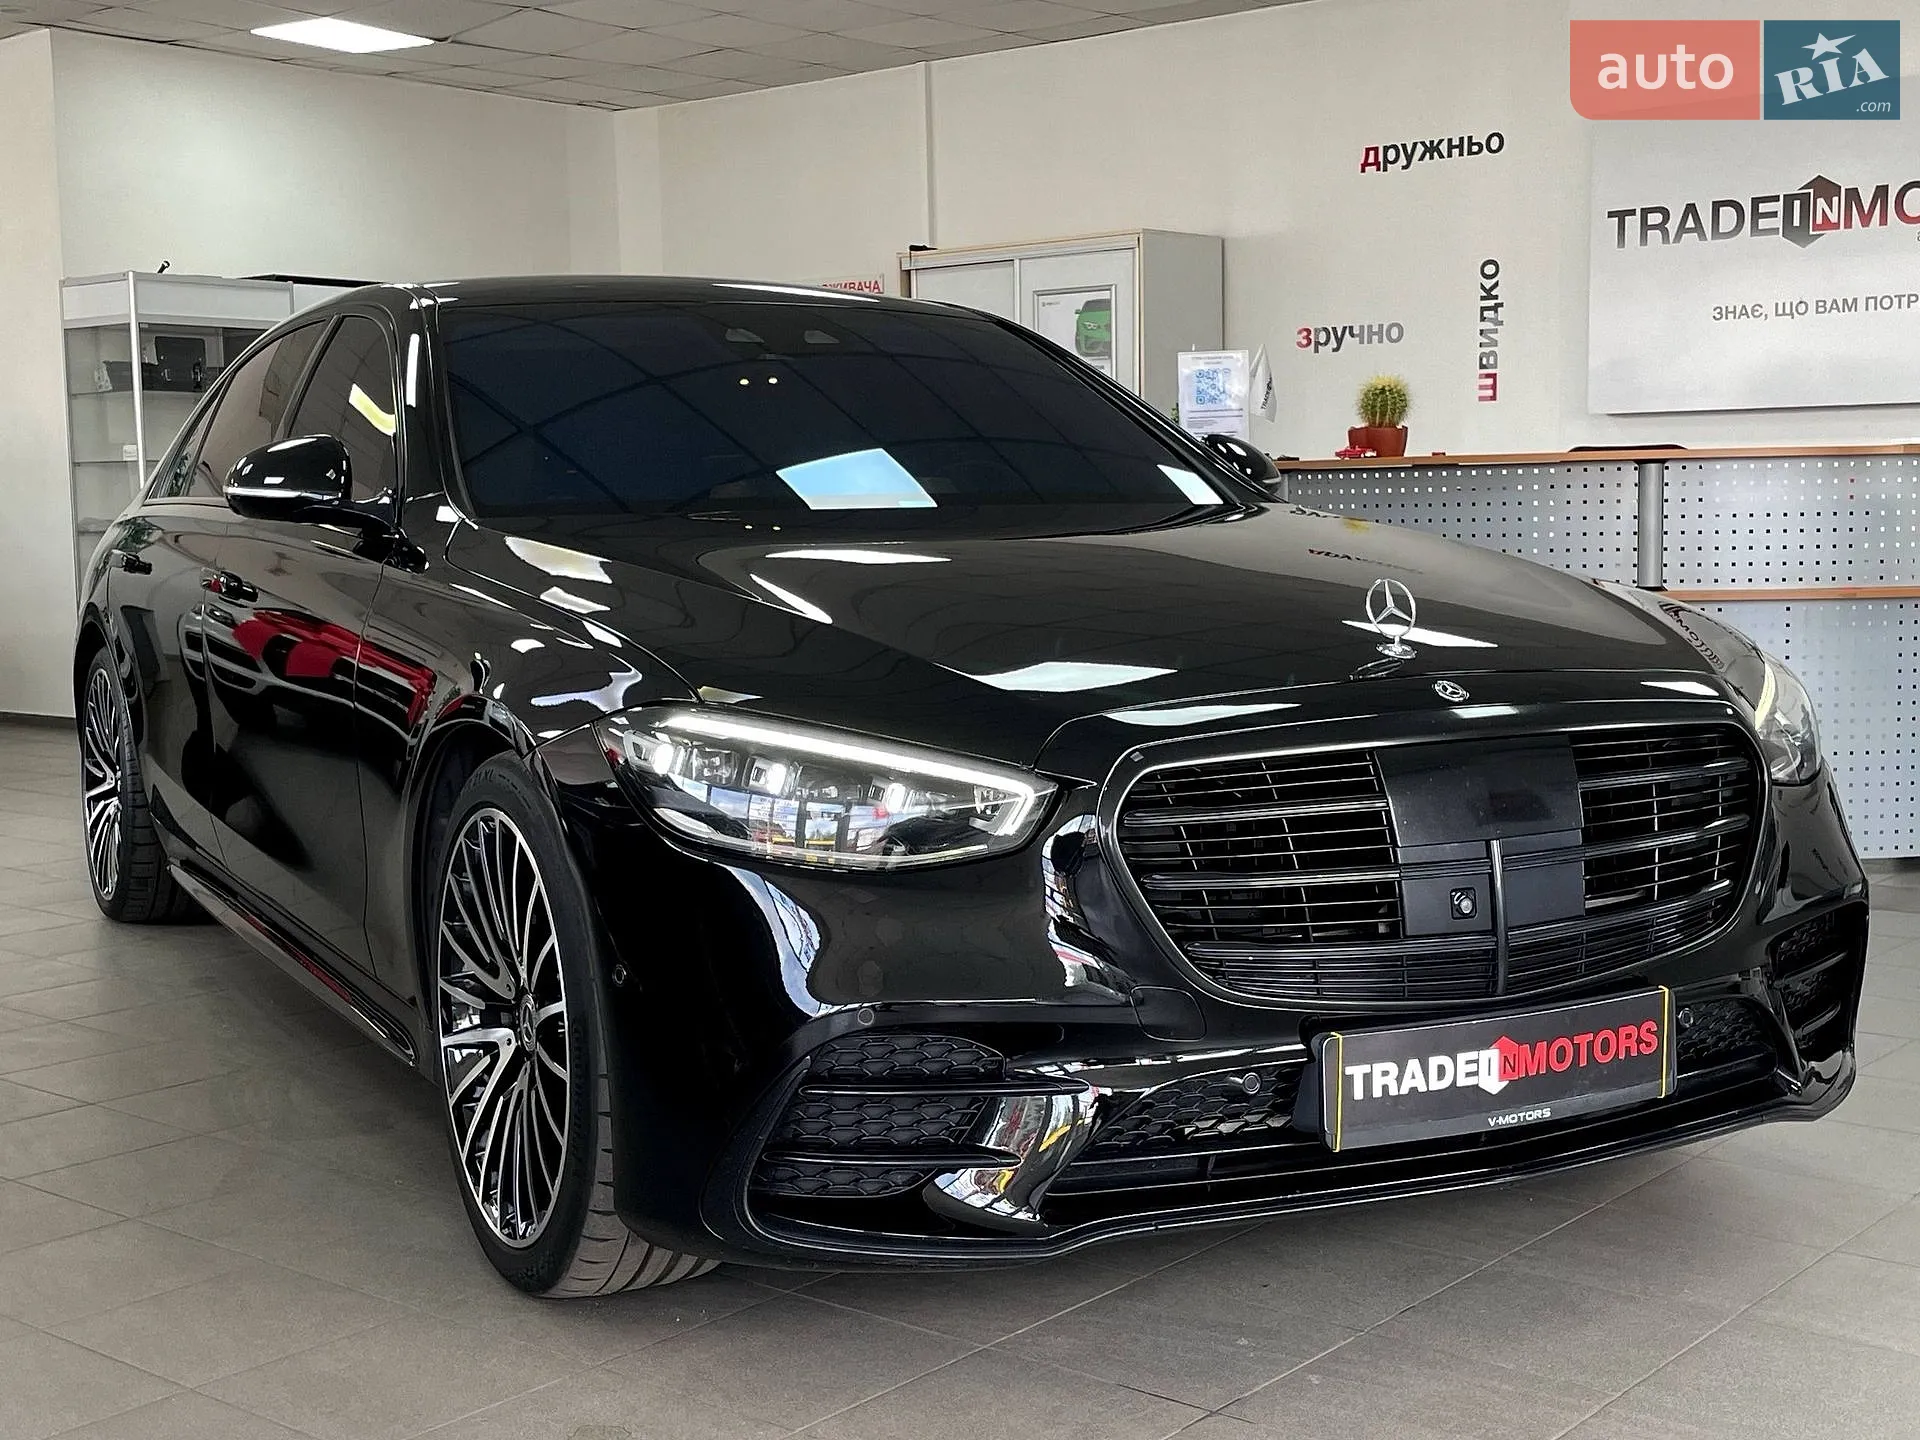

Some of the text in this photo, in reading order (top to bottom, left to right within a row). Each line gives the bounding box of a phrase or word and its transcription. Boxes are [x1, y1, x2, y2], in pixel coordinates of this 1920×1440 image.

[1360, 131, 1505, 173] дружньо
[1712, 303, 1769, 321] ЗНАЄ,
[1774, 299, 1809, 319] ЩО
[1815, 297, 1858, 315] ВАМ
[1296, 322, 1405, 353] зручно
[1477, 258, 1504, 402] швидко
[1487, 1107, 1551, 1127] V-MOTORS
